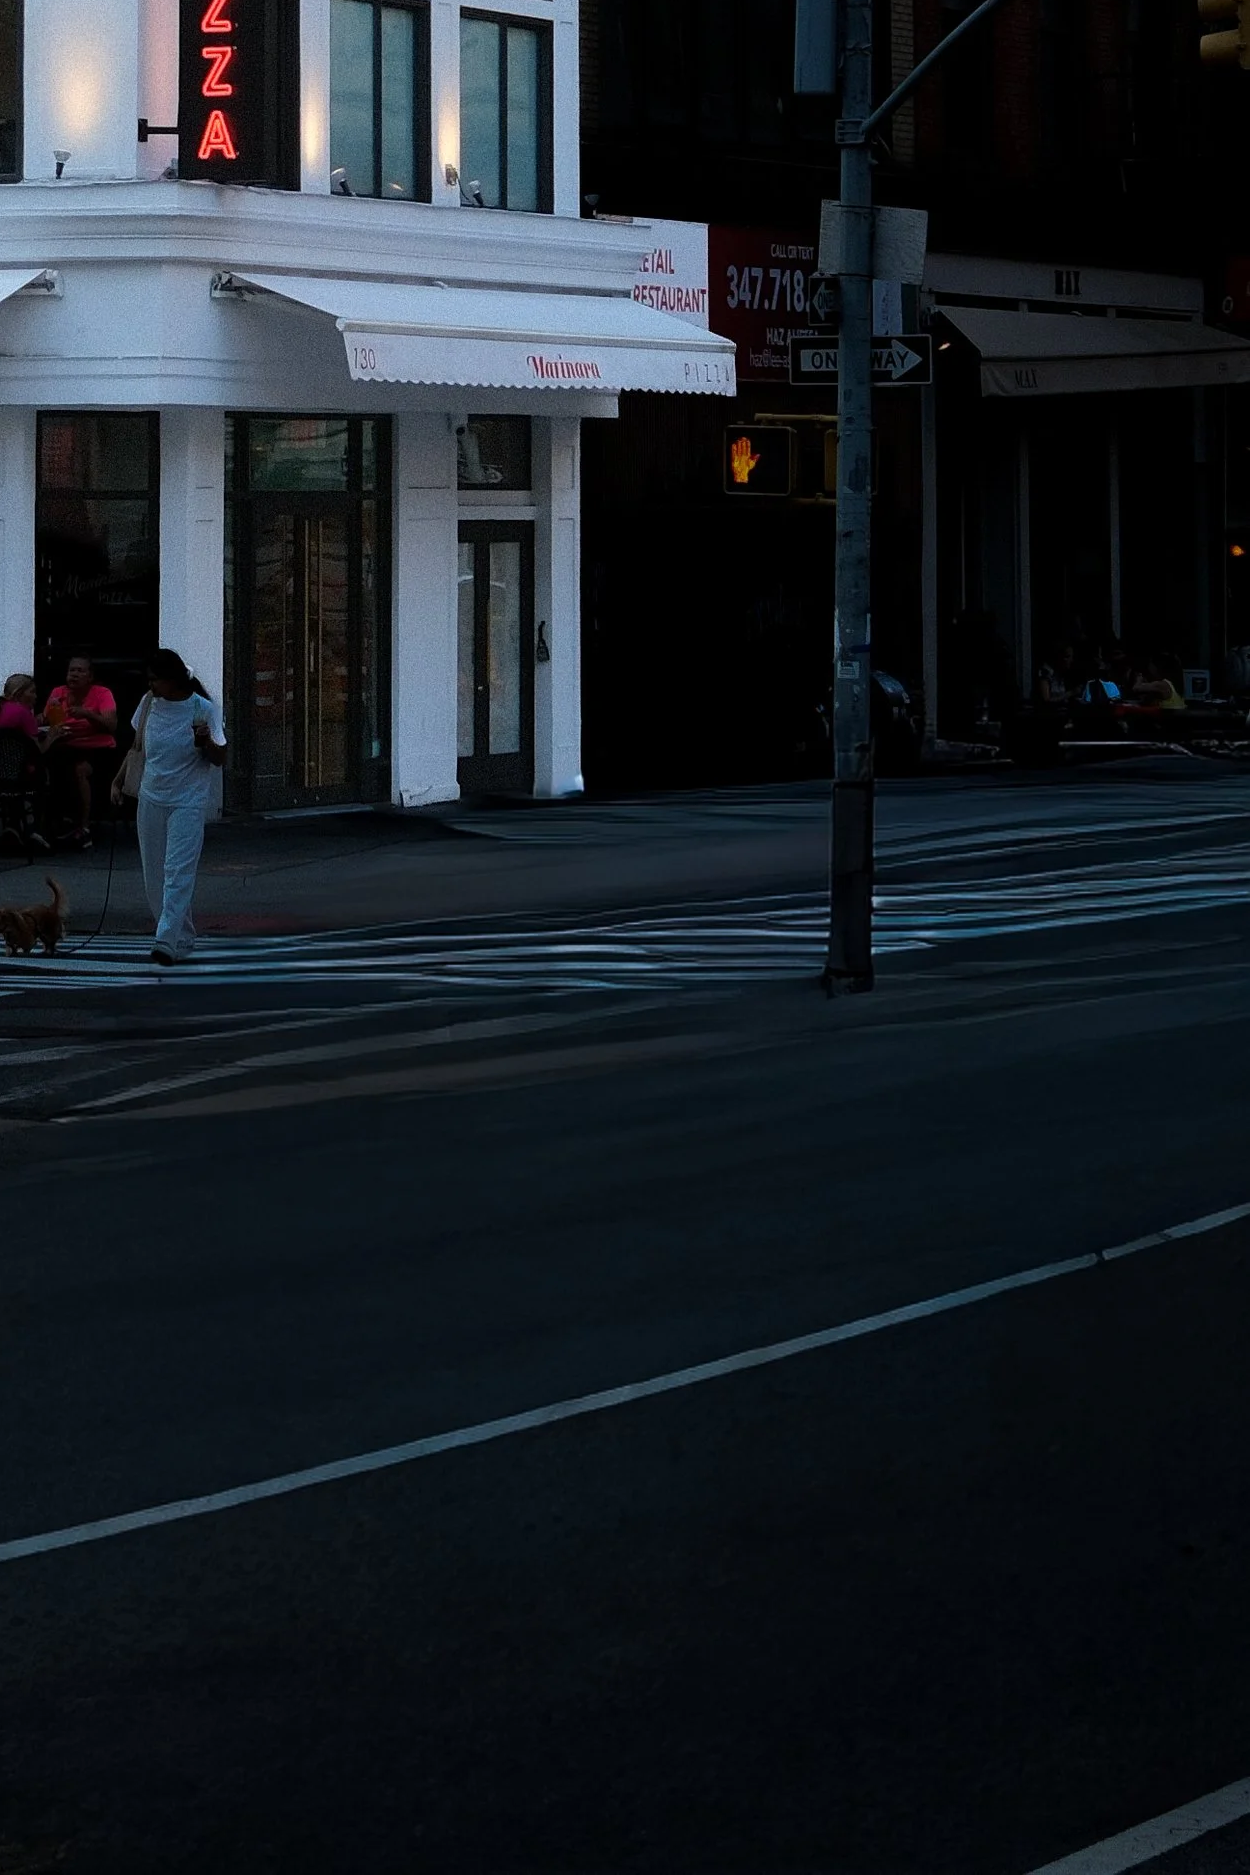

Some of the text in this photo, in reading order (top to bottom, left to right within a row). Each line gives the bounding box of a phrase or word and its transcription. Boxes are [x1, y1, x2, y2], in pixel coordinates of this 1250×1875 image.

[640, 248, 675, 274] ETAIL
[770, 243, 787, 258] CALL
[798, 245, 815, 260] TEXT
[634, 285, 707, 313] RESTAURANT
[726, 264, 810, 313] 347.718.
[354, 347, 376, 370] 130
[526, 353, 602, 380] Marinara
[811, 351, 909, 369] ON WAY
